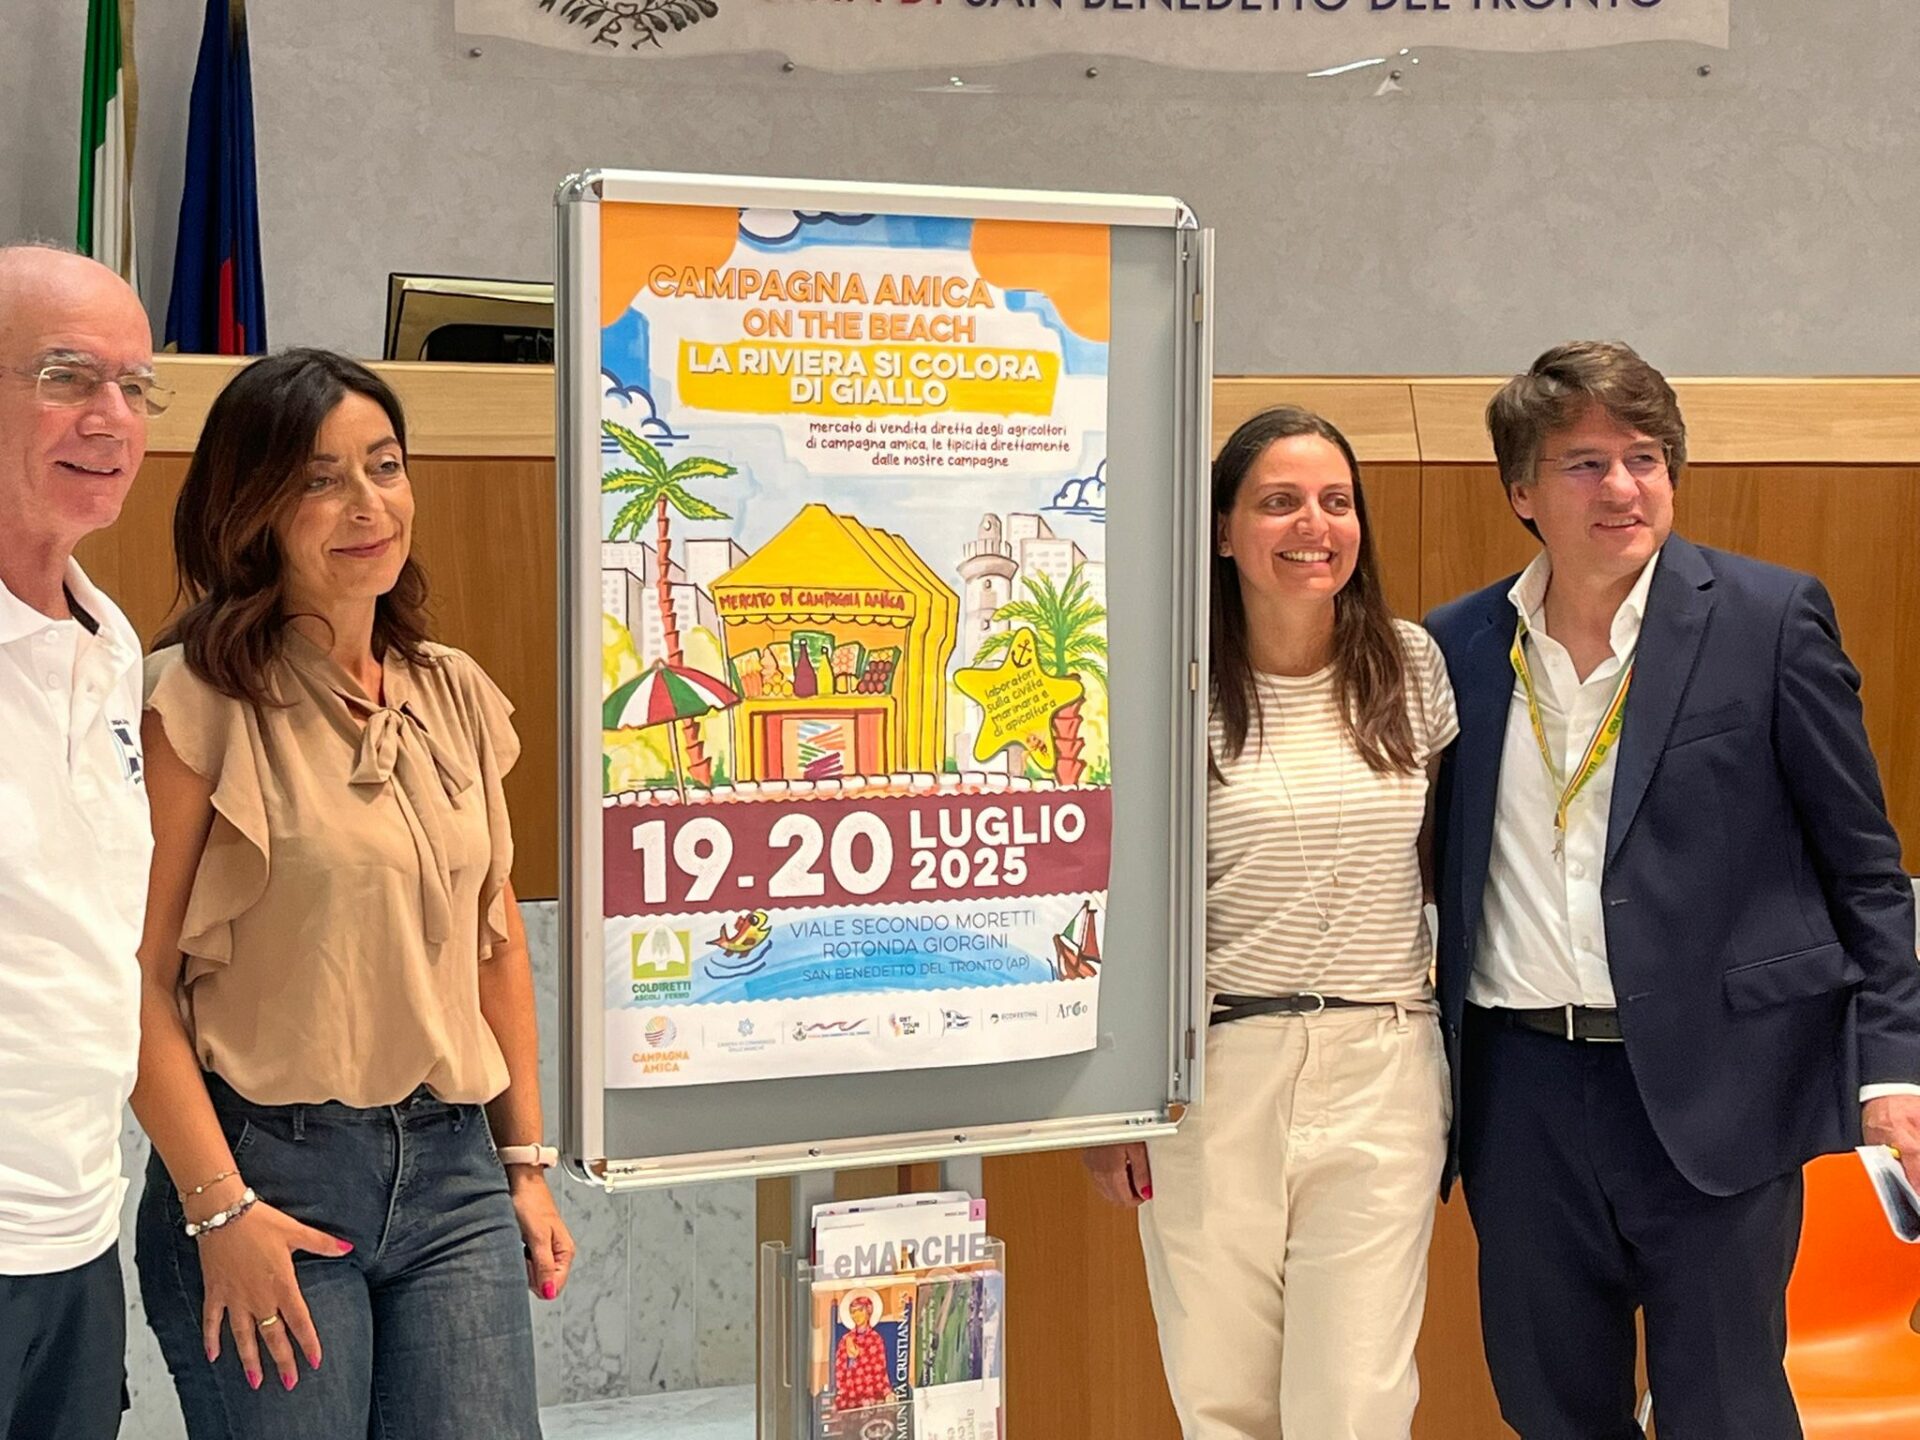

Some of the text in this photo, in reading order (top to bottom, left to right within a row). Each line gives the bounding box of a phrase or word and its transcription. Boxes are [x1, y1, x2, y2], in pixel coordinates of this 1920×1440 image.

[648, 264, 995, 309] CAMPAGNA AMICA
[743, 308, 976, 342] ON THE BEACH
[688, 346, 1042, 382] LA RIVIERA SI COLORA
[791, 379, 948, 407] DI GIALLO
[810, 421, 1067, 438] mercato di vendita diretta degli agricoltori
[806, 437, 1070, 453] di campagna amica, le tipicità direttamente
[872, 453, 1009, 469] dalle nostre campagne
[718, 592, 775, 610] MERCATO
[985, 668, 1036, 699] laboratori
[987, 696, 1010, 713] sulla
[991, 689, 1049, 721] marinara e
[993, 698, 1057, 737] di apicoltura
[909, 803, 1087, 850] LUGLIO
[909, 846, 1029, 890] 2025
[790, 910, 1036, 938] VIALE SECONDO MORETTI
[823, 934, 1008, 959] ROTONDA GIORGINI
[803, 955, 1030, 982] SAN BENEDETTO DEL TRONTO (AP)
[632, 981, 692, 993] COLDIRETTI
[634, 993, 661, 1001] ASCOLI
[632, 1051, 690, 1063] CAMPAGNA
[642, 1063, 680, 1074] AMICA
[895, 1309, 909, 1382] CRISTIANA
